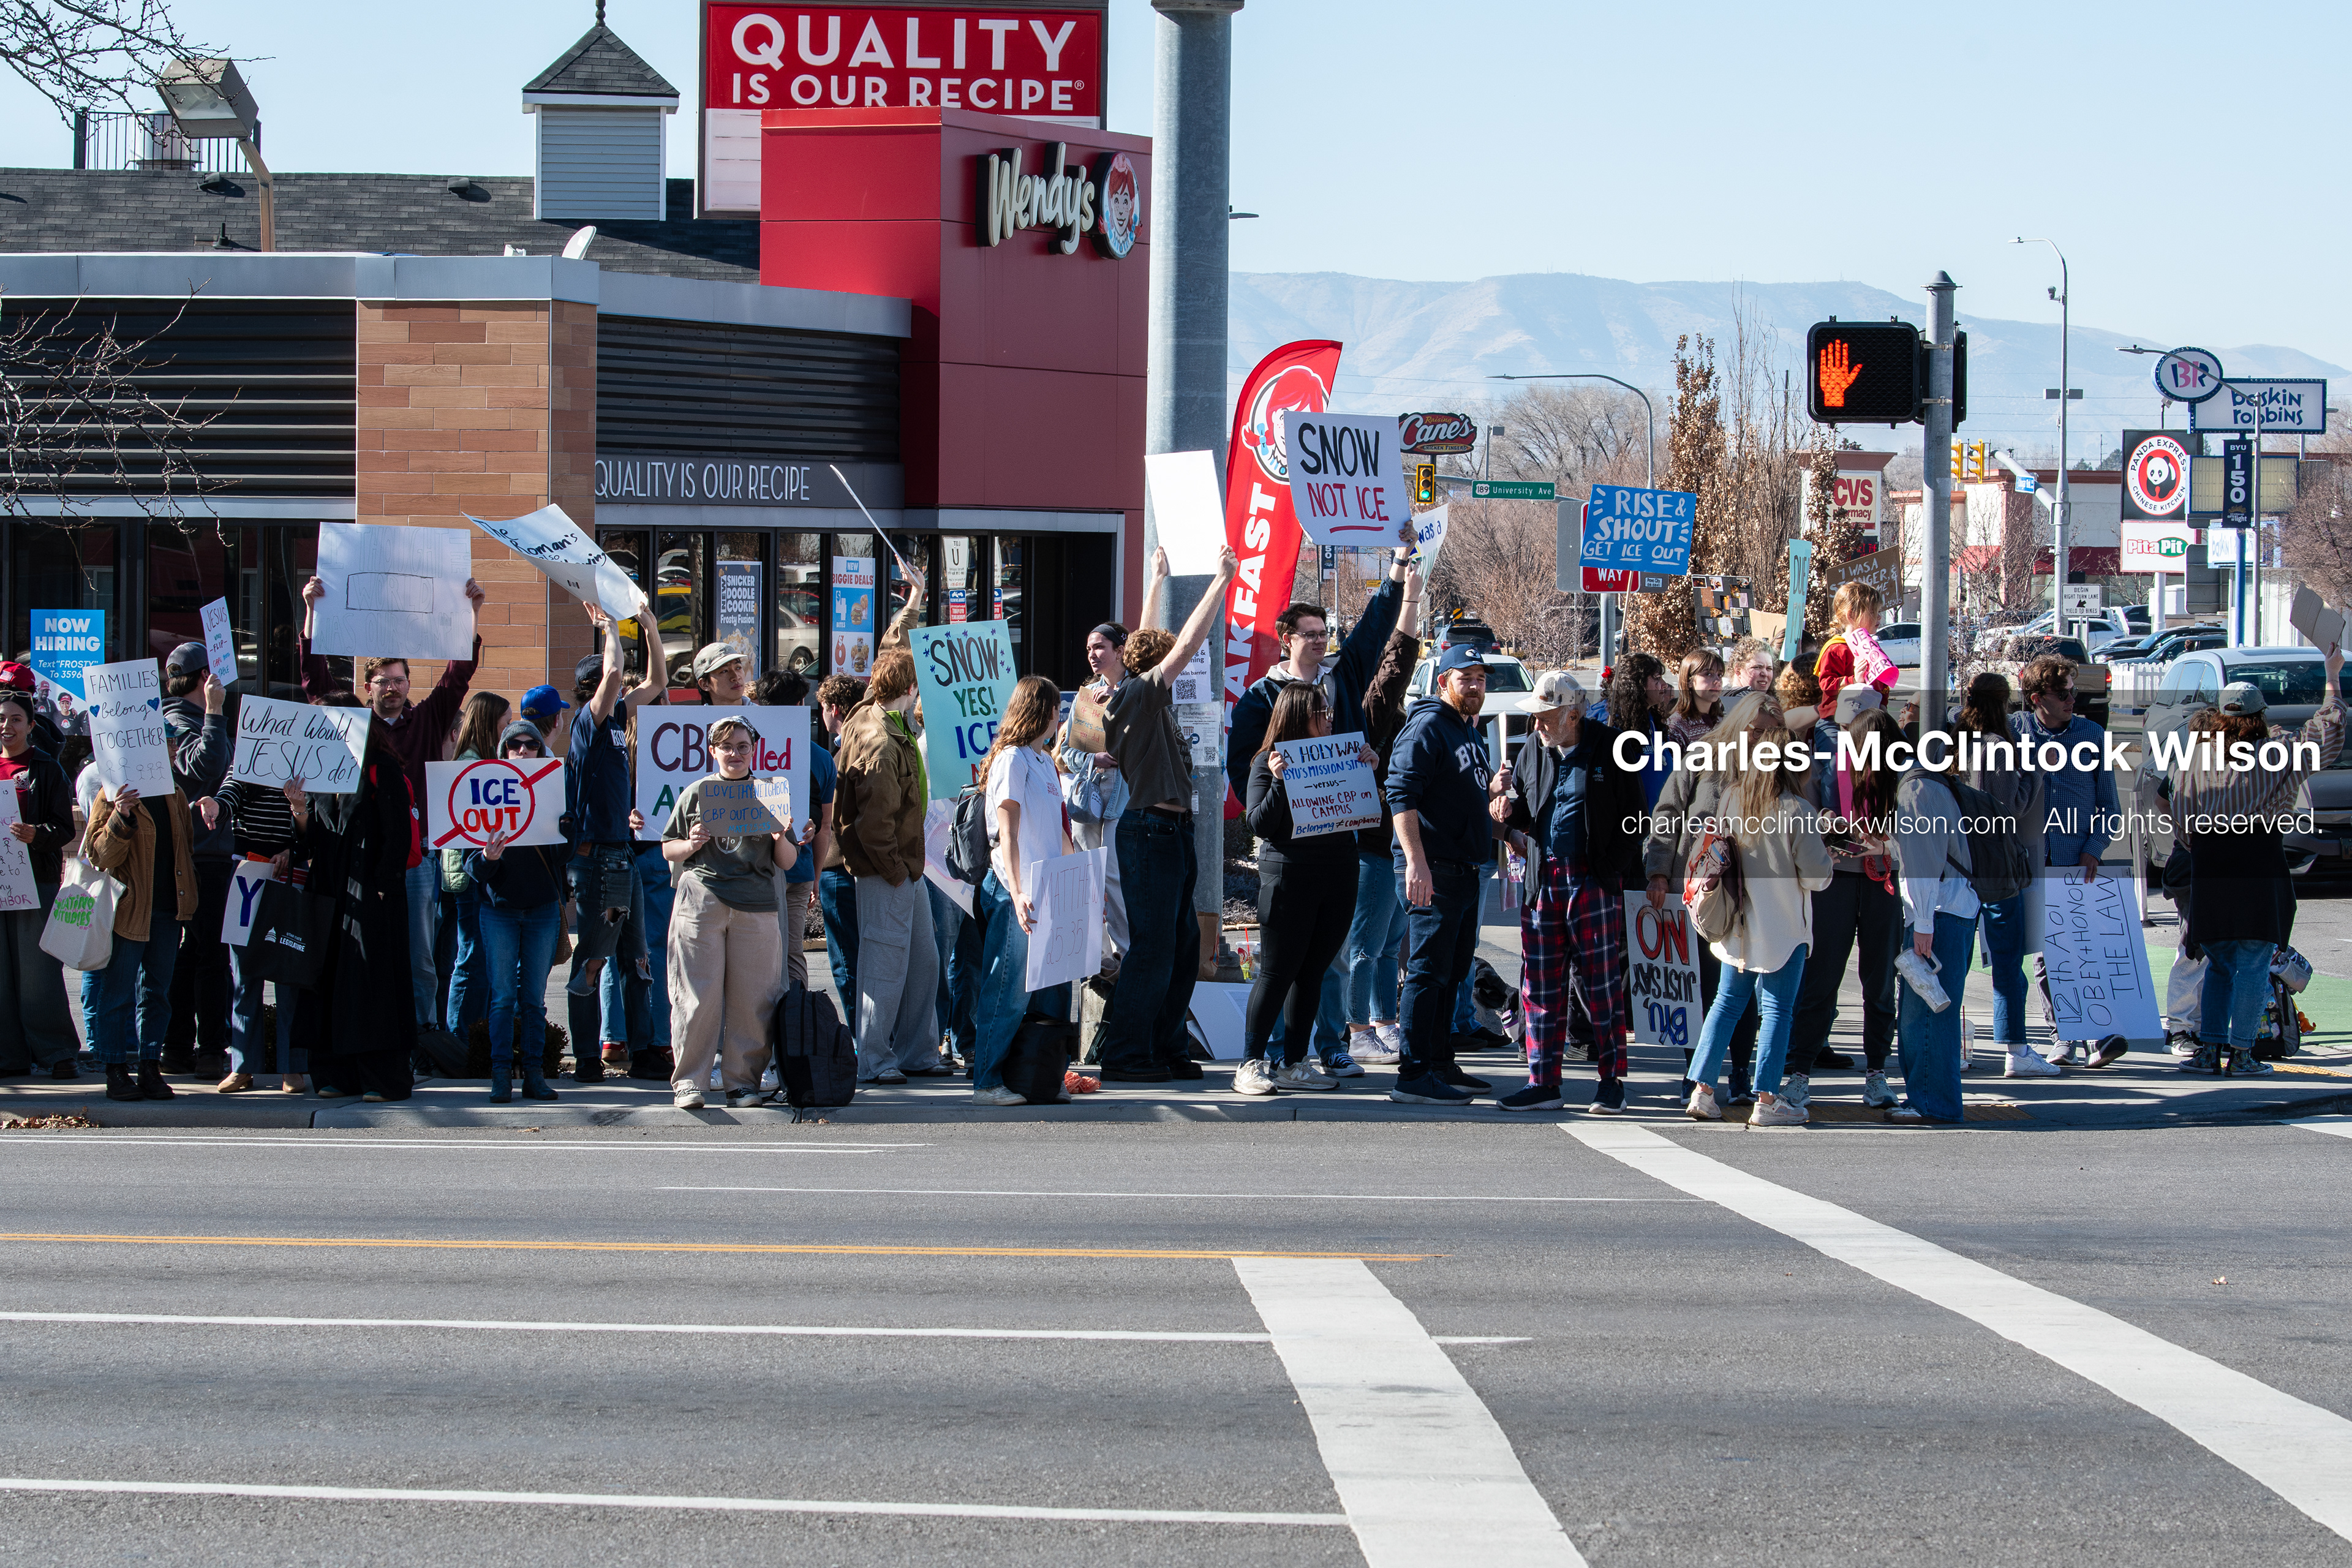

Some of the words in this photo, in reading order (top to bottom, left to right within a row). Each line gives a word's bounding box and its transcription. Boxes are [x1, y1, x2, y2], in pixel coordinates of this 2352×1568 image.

[732, 13, 1076, 72] QUALITY
[733, 74, 770, 104] IS
[791, 75, 886, 107] OUR
[987, 141, 1095, 255] Wendy's
[2171, 361, 2209, 388] BR
[1399, 414, 1475, 450] Cane's
[1298, 422, 1379, 477] SNOW
[2130, 441, 2154, 471] PANDA
[595, 460, 676, 498] QUALITY
[680, 463, 695, 498] IS
[704, 463, 742, 499] OUR
[748, 465, 810, 500] RECIPE
[1493, 486, 1532, 496] University
[1833, 478, 1873, 506] CVS
[1306, 482, 1348, 517] NOT
[1355, 486, 1390, 521] ICE
[1615, 490, 1674, 518] RISE
[1675, 497, 1686, 517] &
[2133, 486, 2157, 511] CHINESE
[2160, 487, 2185, 511] KITCHEN
[472, 519, 519, 540] The
[1419, 522, 1434, 545] was
[1593, 516, 1679, 543] SHOUT
[1583, 541, 1614, 557] GET
[1621, 544, 1643, 557] ICE
[1651, 545, 1684, 561] OUT
[2127, 539, 2160, 554] Pita
[2160, 540, 2183, 554] Pit
[833, 573, 853, 585] BIGGIE
[854, 575, 873, 586] DEALS
[847, 562, 859, 571] NEW
[1597, 568, 1623, 581] WAY
[1793, 555, 1807, 595] DUE
[352, 573, 431, 612] WORLD
[726, 575, 755, 586] SNICKER
[726, 587, 755, 600] DOODLE
[206, 607, 227, 631] JESUS
[726, 600, 755, 612] COOKIE
[1225, 483, 1278, 729] AKFAST
[45, 618, 91, 633] NOW
[720, 614, 737, 626] Frosty
[737, 613, 754, 624] Fusion
[35, 636, 100, 652] HIRING
[930, 636, 1000, 687] SNOW
[90, 669, 159, 695] FAMILIES
[101, 701, 151, 720] belong
[952, 686, 997, 717] YES!
[241, 705, 298, 736] What
[304, 713, 353, 742] Would
[96, 726, 165, 750] TOGETHER
[238, 736, 328, 780] JESUS
[328, 755, 358, 785] do?
[1283, 749, 1294, 764] A
[1299, 743, 1333, 763] HOLY
[1335, 741, 1362, 757] WAR
[1308, 761, 1344, 777] MISSION
[470, 778, 521, 805] ICE
[706, 785, 734, 799] LOVE
[737, 783, 753, 799] THY
[754, 780, 788, 797] NEIGHBOR
[1292, 794, 1335, 809] ALLOWING
[1337, 791, 1357, 804] CBP
[464, 807, 521, 833] OUT
[703, 808, 725, 823] CBP
[729, 807, 749, 821] OUT
[750, 806, 764, 820] OF
[1311, 804, 1352, 819] CAMPUS
[728, 824, 748, 833] MATT
[1295, 821, 1335, 835] Belonging
[1344, 816, 1381, 827] compliance
[9, 865, 20, 876] to
[235, 875, 266, 927] Y
[1041, 862, 1102, 925] MATTHEW
[2095, 873, 2125, 936] LAW
[279, 937, 306, 952] LEGISLATURE
[1636, 905, 1691, 966] NO
[1662, 966, 1697, 1003] JUST
[2104, 946, 2134, 1000] THE
[2050, 960, 2082, 1023] 12th
